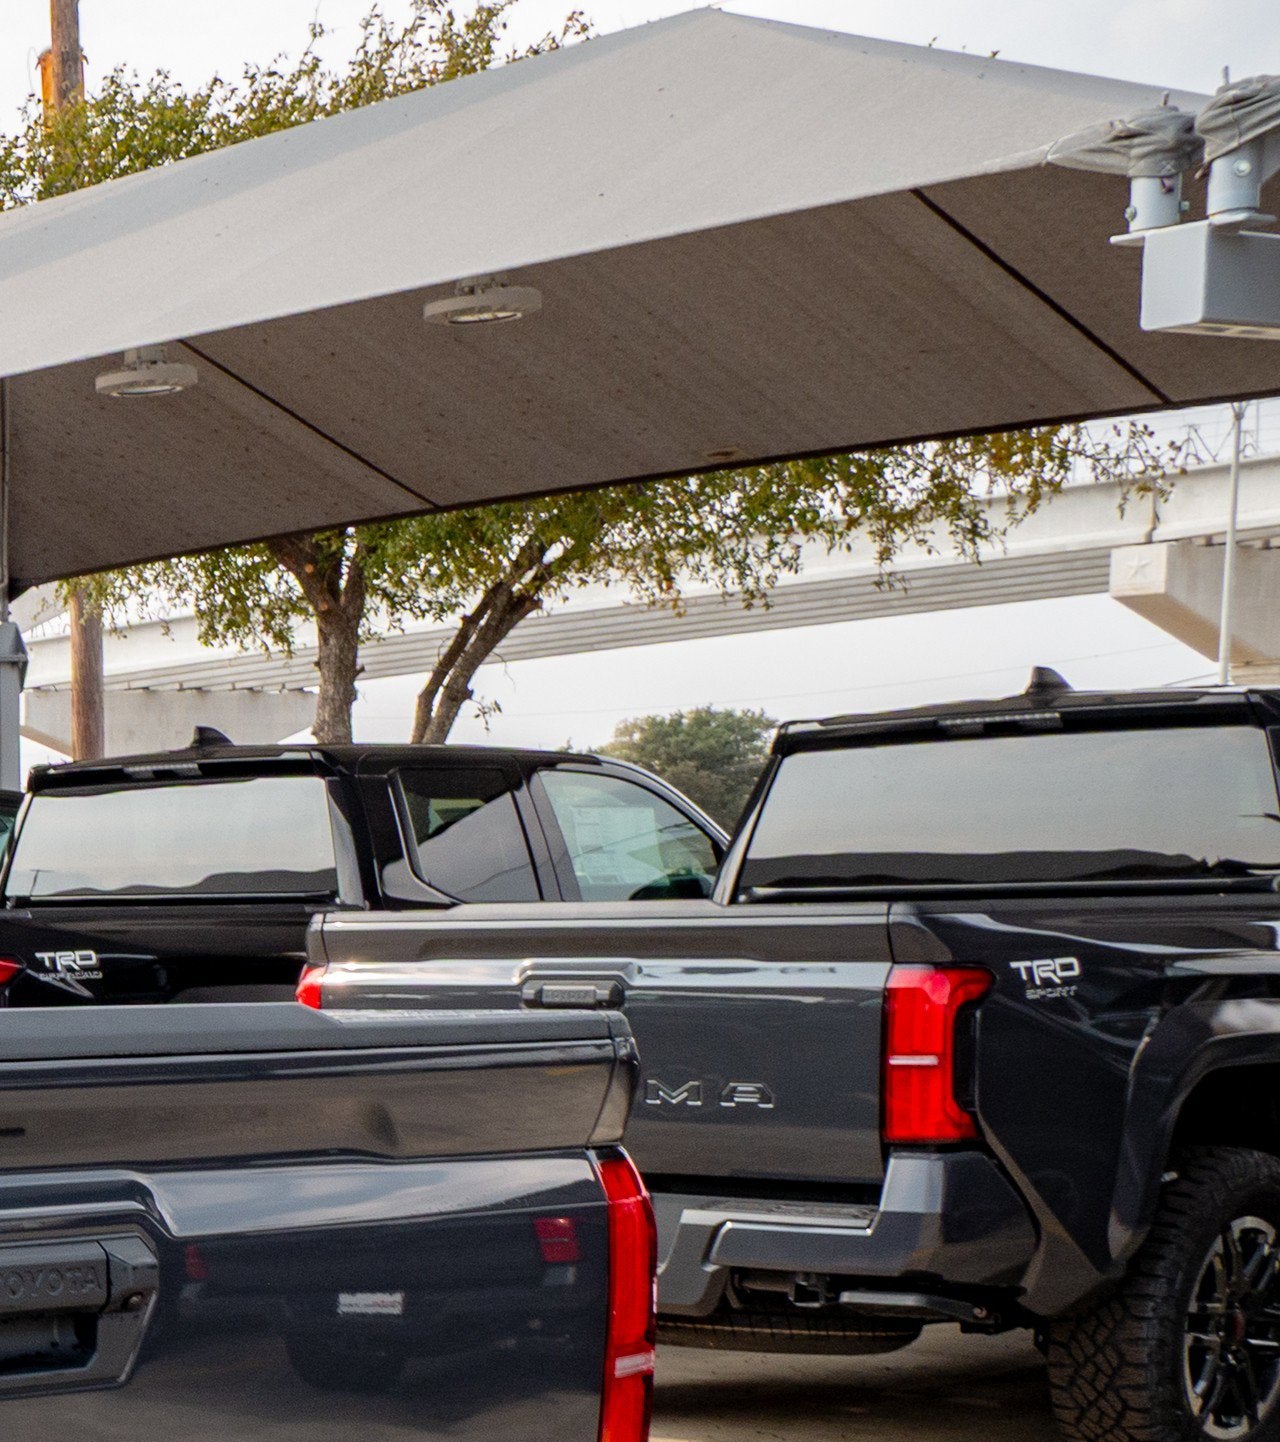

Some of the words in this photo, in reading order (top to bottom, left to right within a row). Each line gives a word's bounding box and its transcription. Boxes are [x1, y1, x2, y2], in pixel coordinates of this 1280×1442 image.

[34, 949, 97, 972] TRD
[1009, 957, 1081, 986] TRD
[1025, 984, 1078, 1000] SPORT
